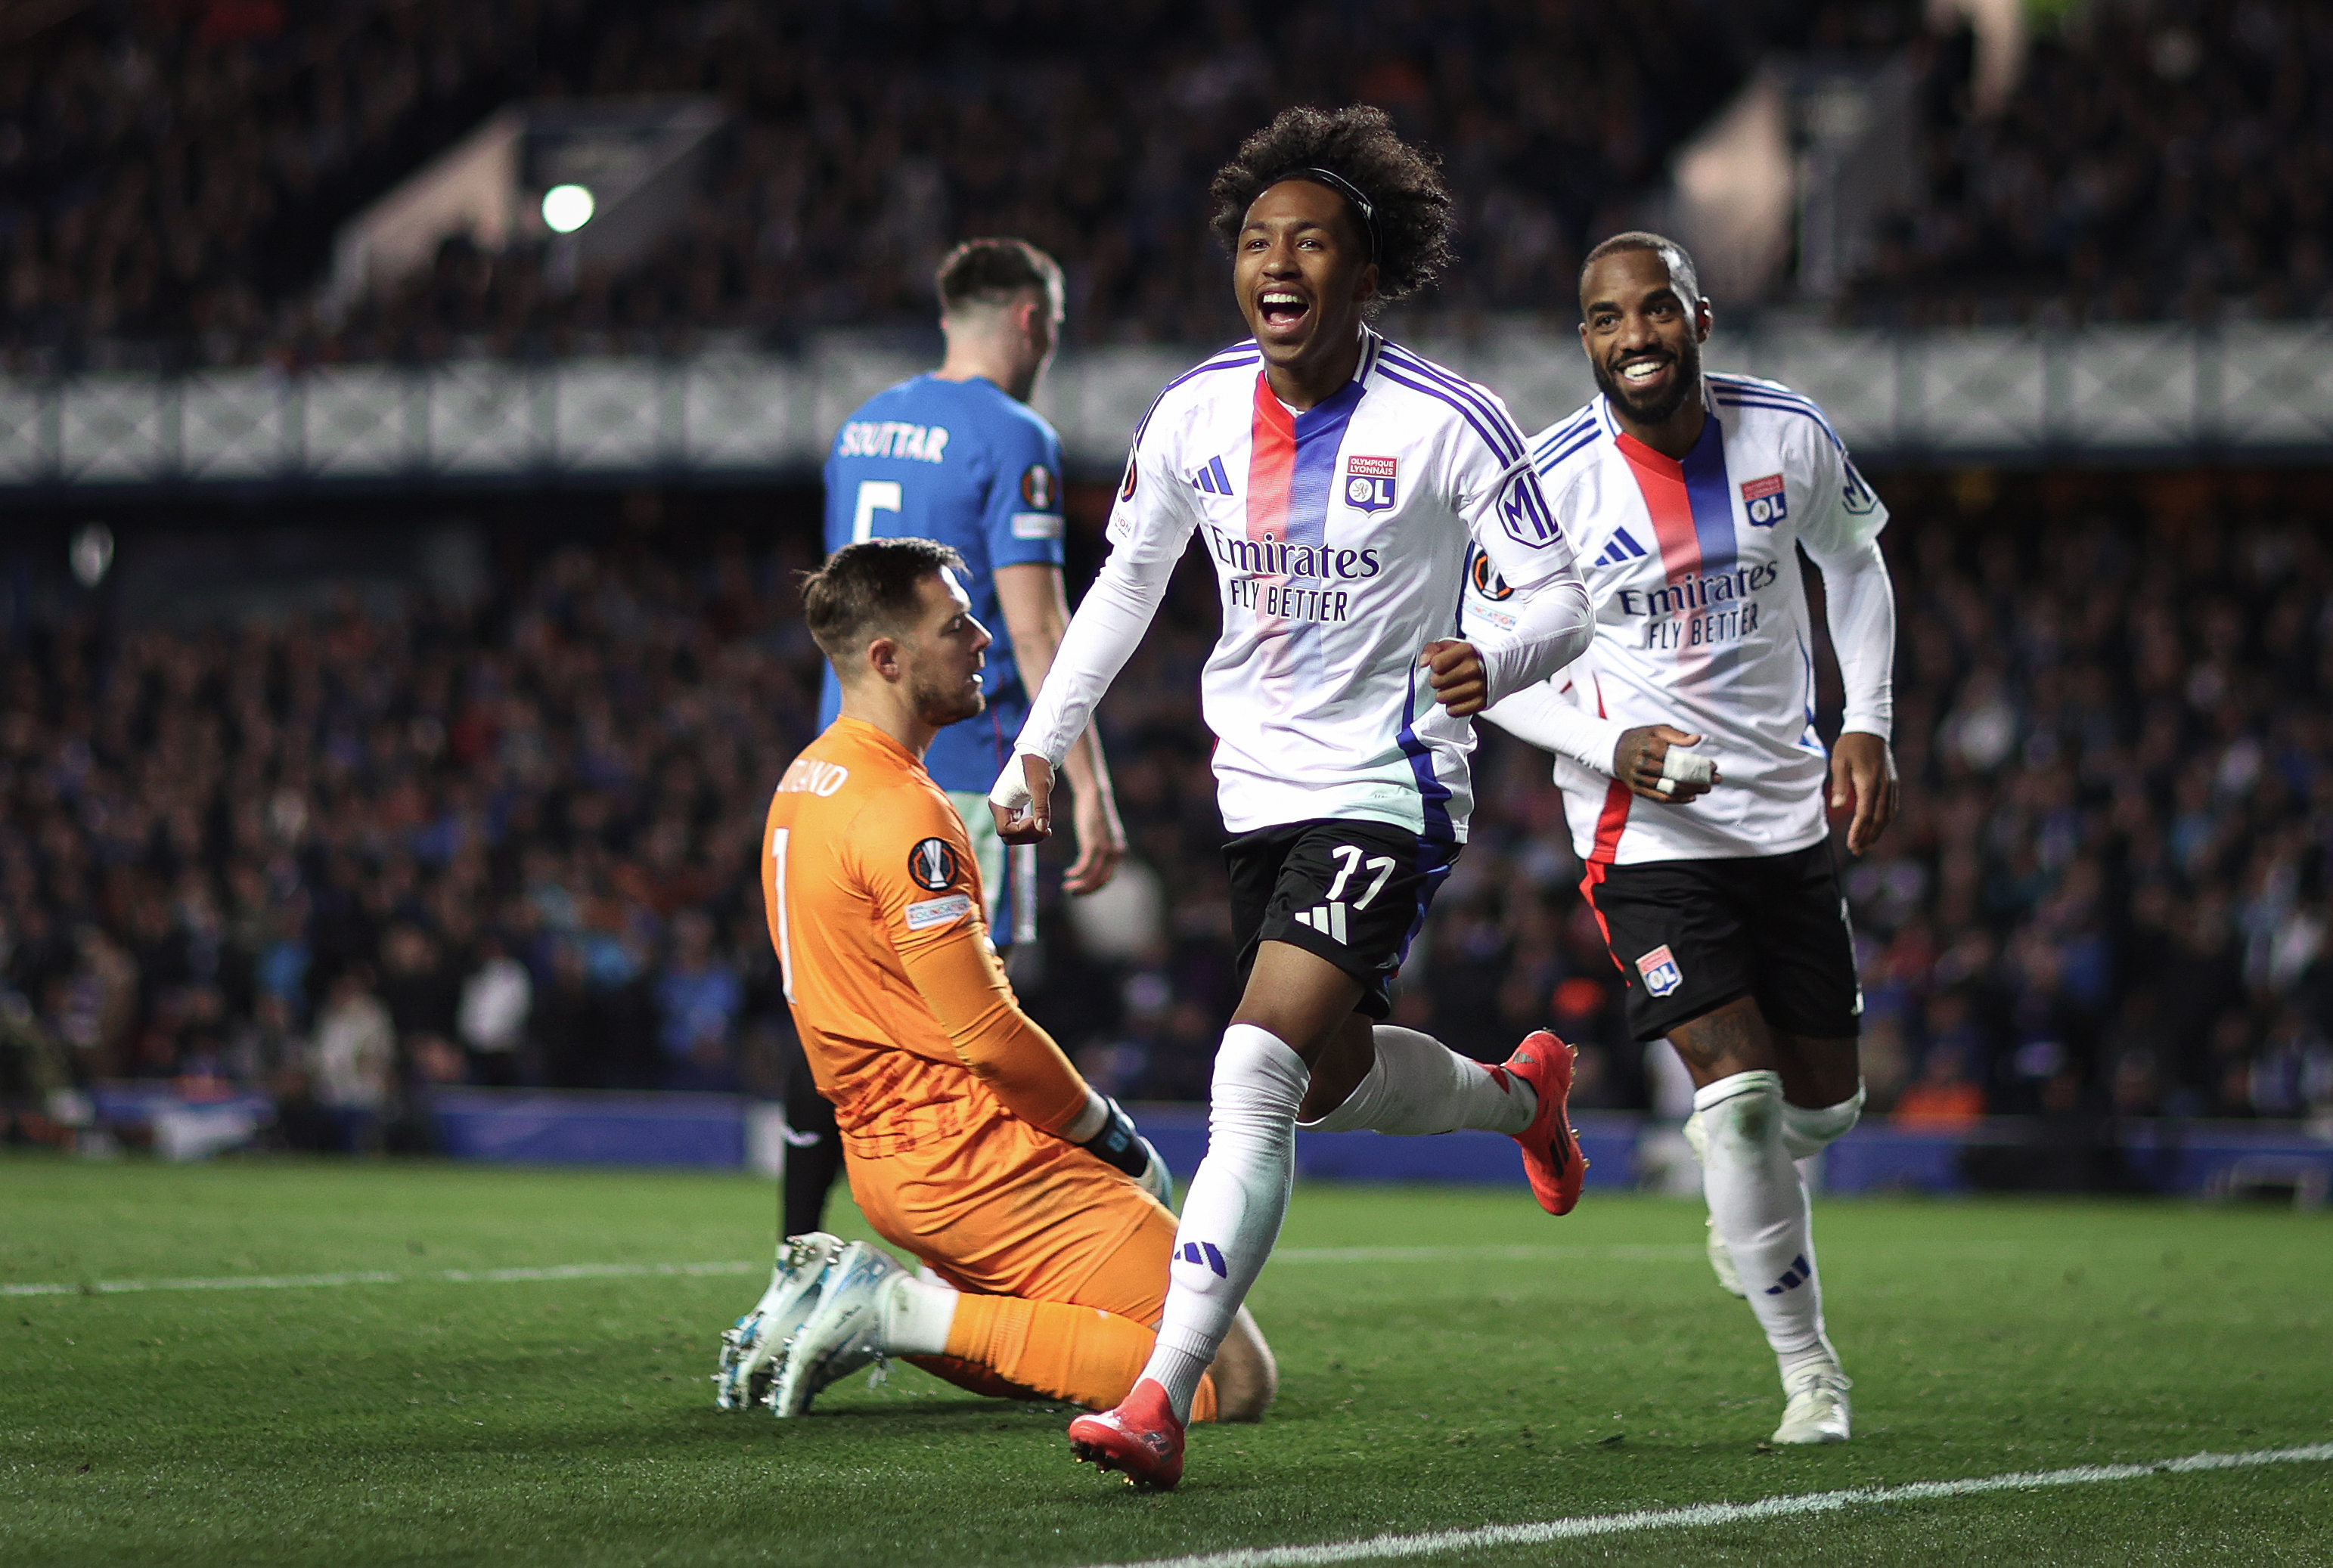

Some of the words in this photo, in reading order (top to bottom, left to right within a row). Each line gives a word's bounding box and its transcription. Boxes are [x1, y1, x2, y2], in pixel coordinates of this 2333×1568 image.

[1350, 466, 1393, 475] LYONNAIS
[1351, 458, 1394, 467] OLYMPIQUE
[1349, 478, 1390, 504] OL
[1751, 496, 1784, 522] OL
[1211, 525, 1379, 578] Emirates
[1230, 580, 1260, 610] FLY
[1267, 586, 1348, 621] BETTER
[1618, 560, 1778, 616] Emirates
[1649, 623, 1681, 649] FLY
[1692, 603, 1758, 645] BETTER
[1325, 845, 1396, 910] 77
[772, 827, 797, 1004] 1
[1649, 965, 1677, 989] OL
